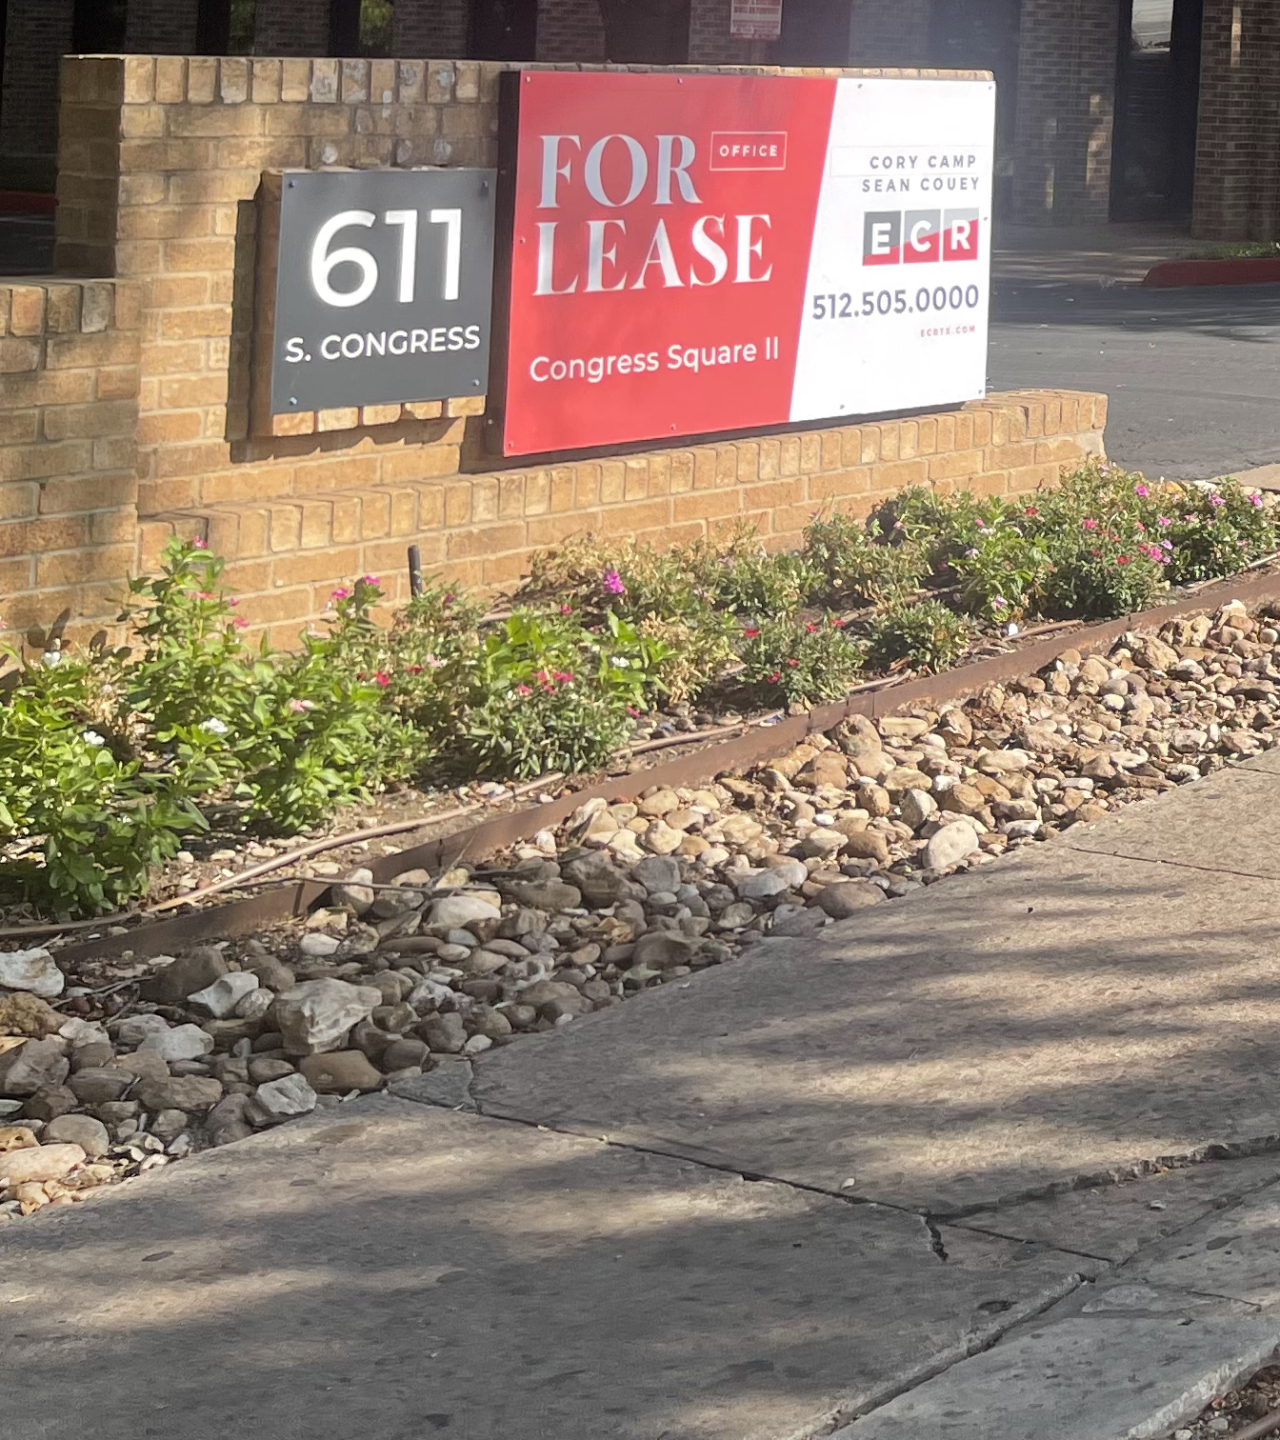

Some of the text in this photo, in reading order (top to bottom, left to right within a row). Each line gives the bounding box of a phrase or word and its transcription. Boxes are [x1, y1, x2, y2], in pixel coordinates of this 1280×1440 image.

[719, 145, 778, 157] OFFICE
[870, 155, 976, 169] CORY CAMP
[536, 133, 704, 208] FOR
[862, 177, 979, 193] SEAN COUEY
[532, 213, 773, 296] LEASE
[871, 219, 971, 255] ECR
[311, 208, 462, 307] 611
[812, 284, 979, 320] 512.505.0000
[285, 325, 480, 363] S. CONGRESS
[920, 325, 976, 337] ECRTX.COM
[529, 336, 779, 383] Congress Square II
